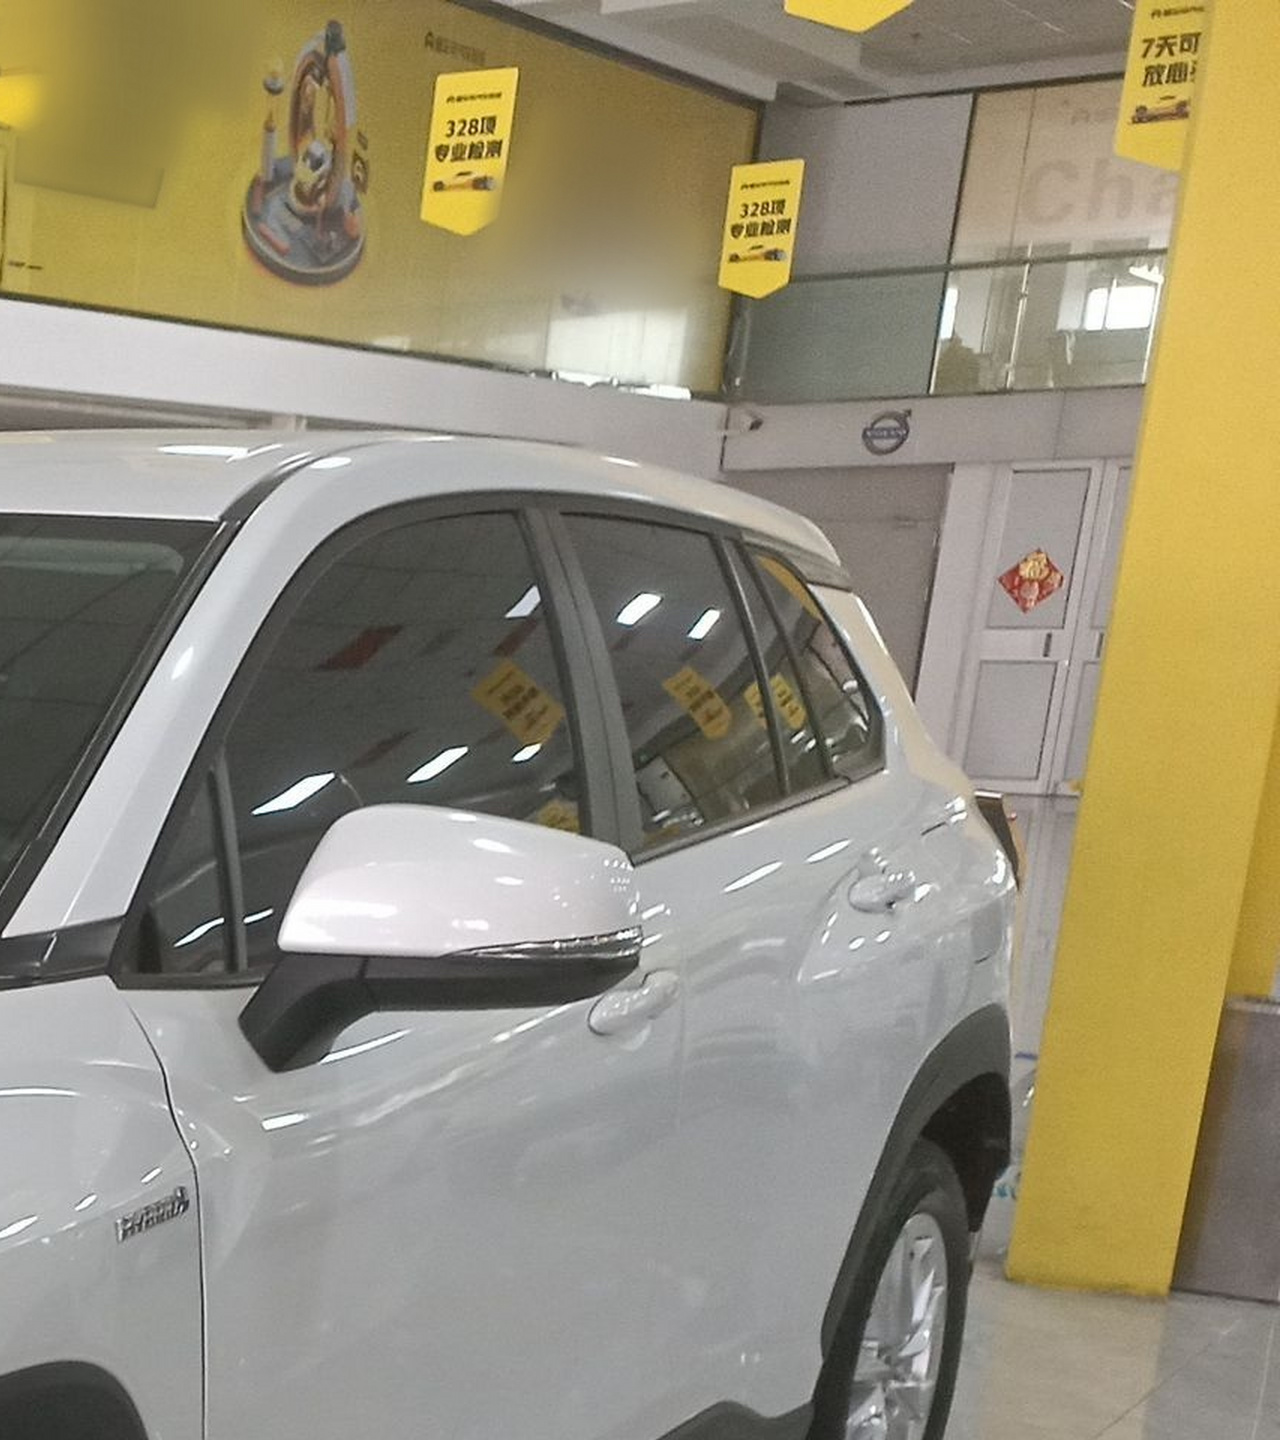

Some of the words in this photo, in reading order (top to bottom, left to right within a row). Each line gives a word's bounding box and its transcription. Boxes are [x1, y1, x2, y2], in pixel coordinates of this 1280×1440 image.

[1142, 61, 1197, 87] 放心
[435, 139, 503, 163] 专业检测
